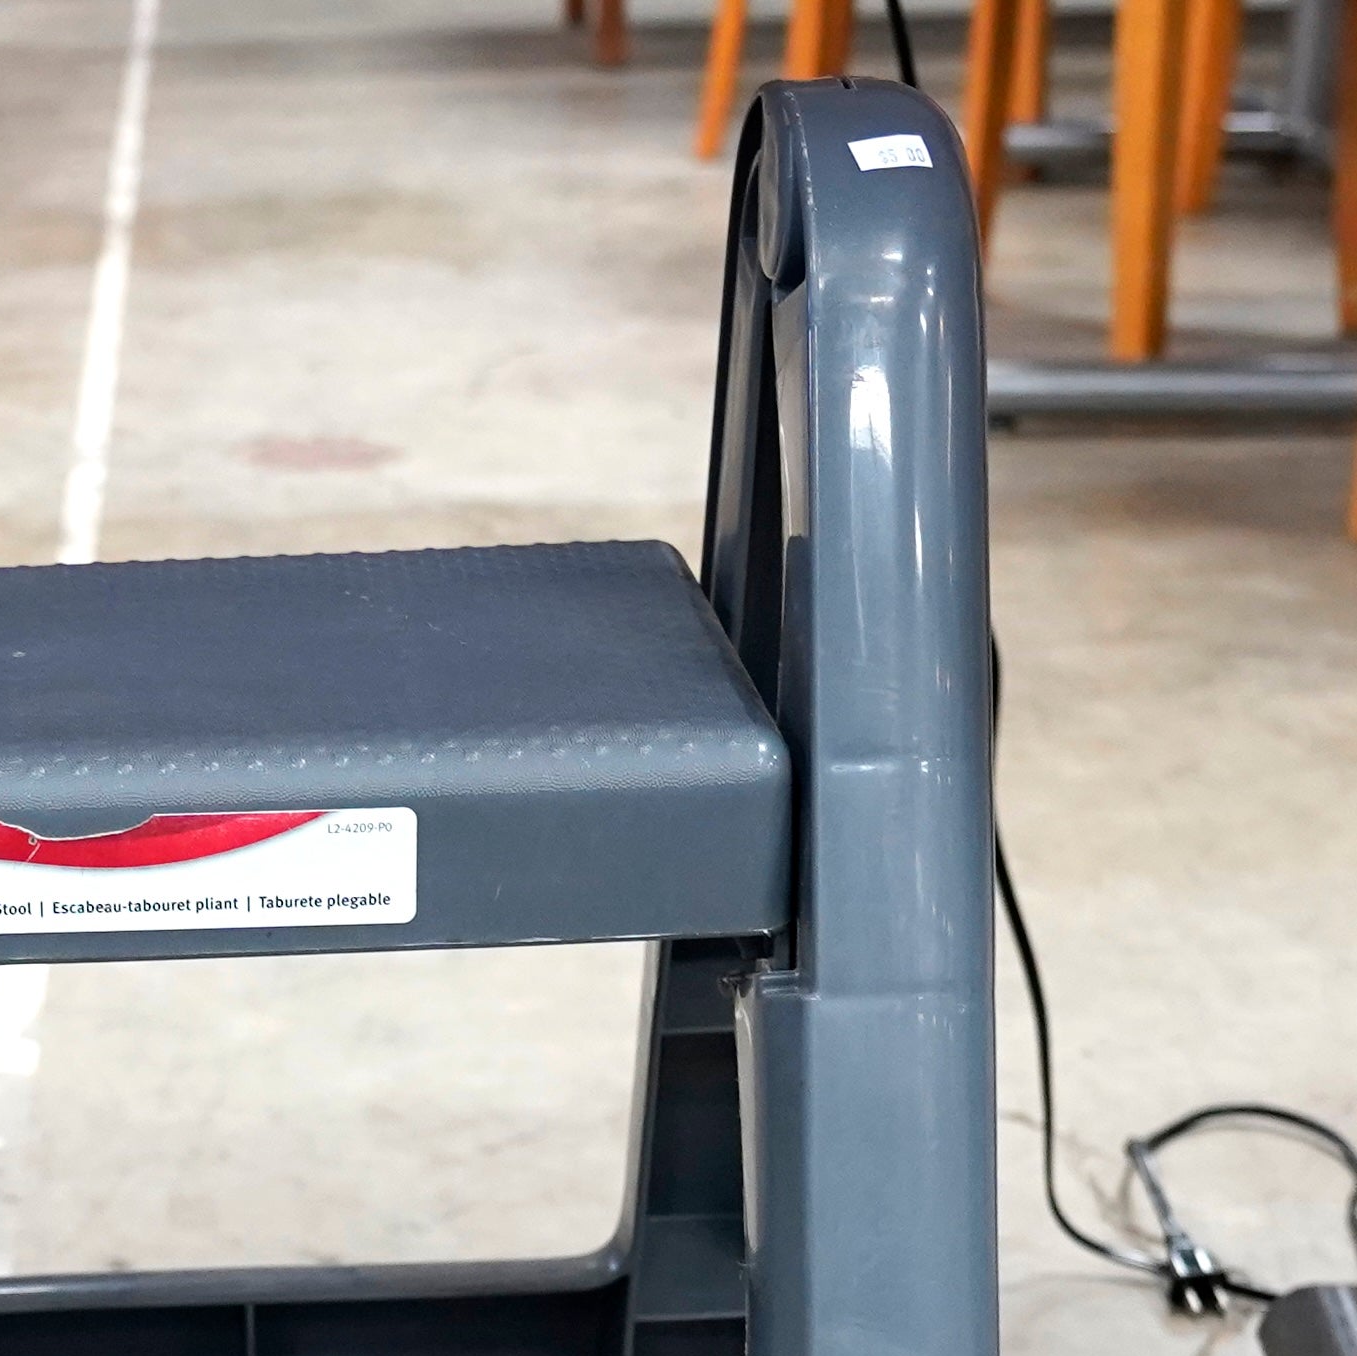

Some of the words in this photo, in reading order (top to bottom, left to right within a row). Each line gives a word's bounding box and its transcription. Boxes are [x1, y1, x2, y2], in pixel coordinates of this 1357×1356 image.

[52, 898, 192, 915] Escabeau-tabouret
[195, 897, 239, 914] pliant
[258, 895, 323, 910] Taburete
[327, 892, 392, 911] plegable
